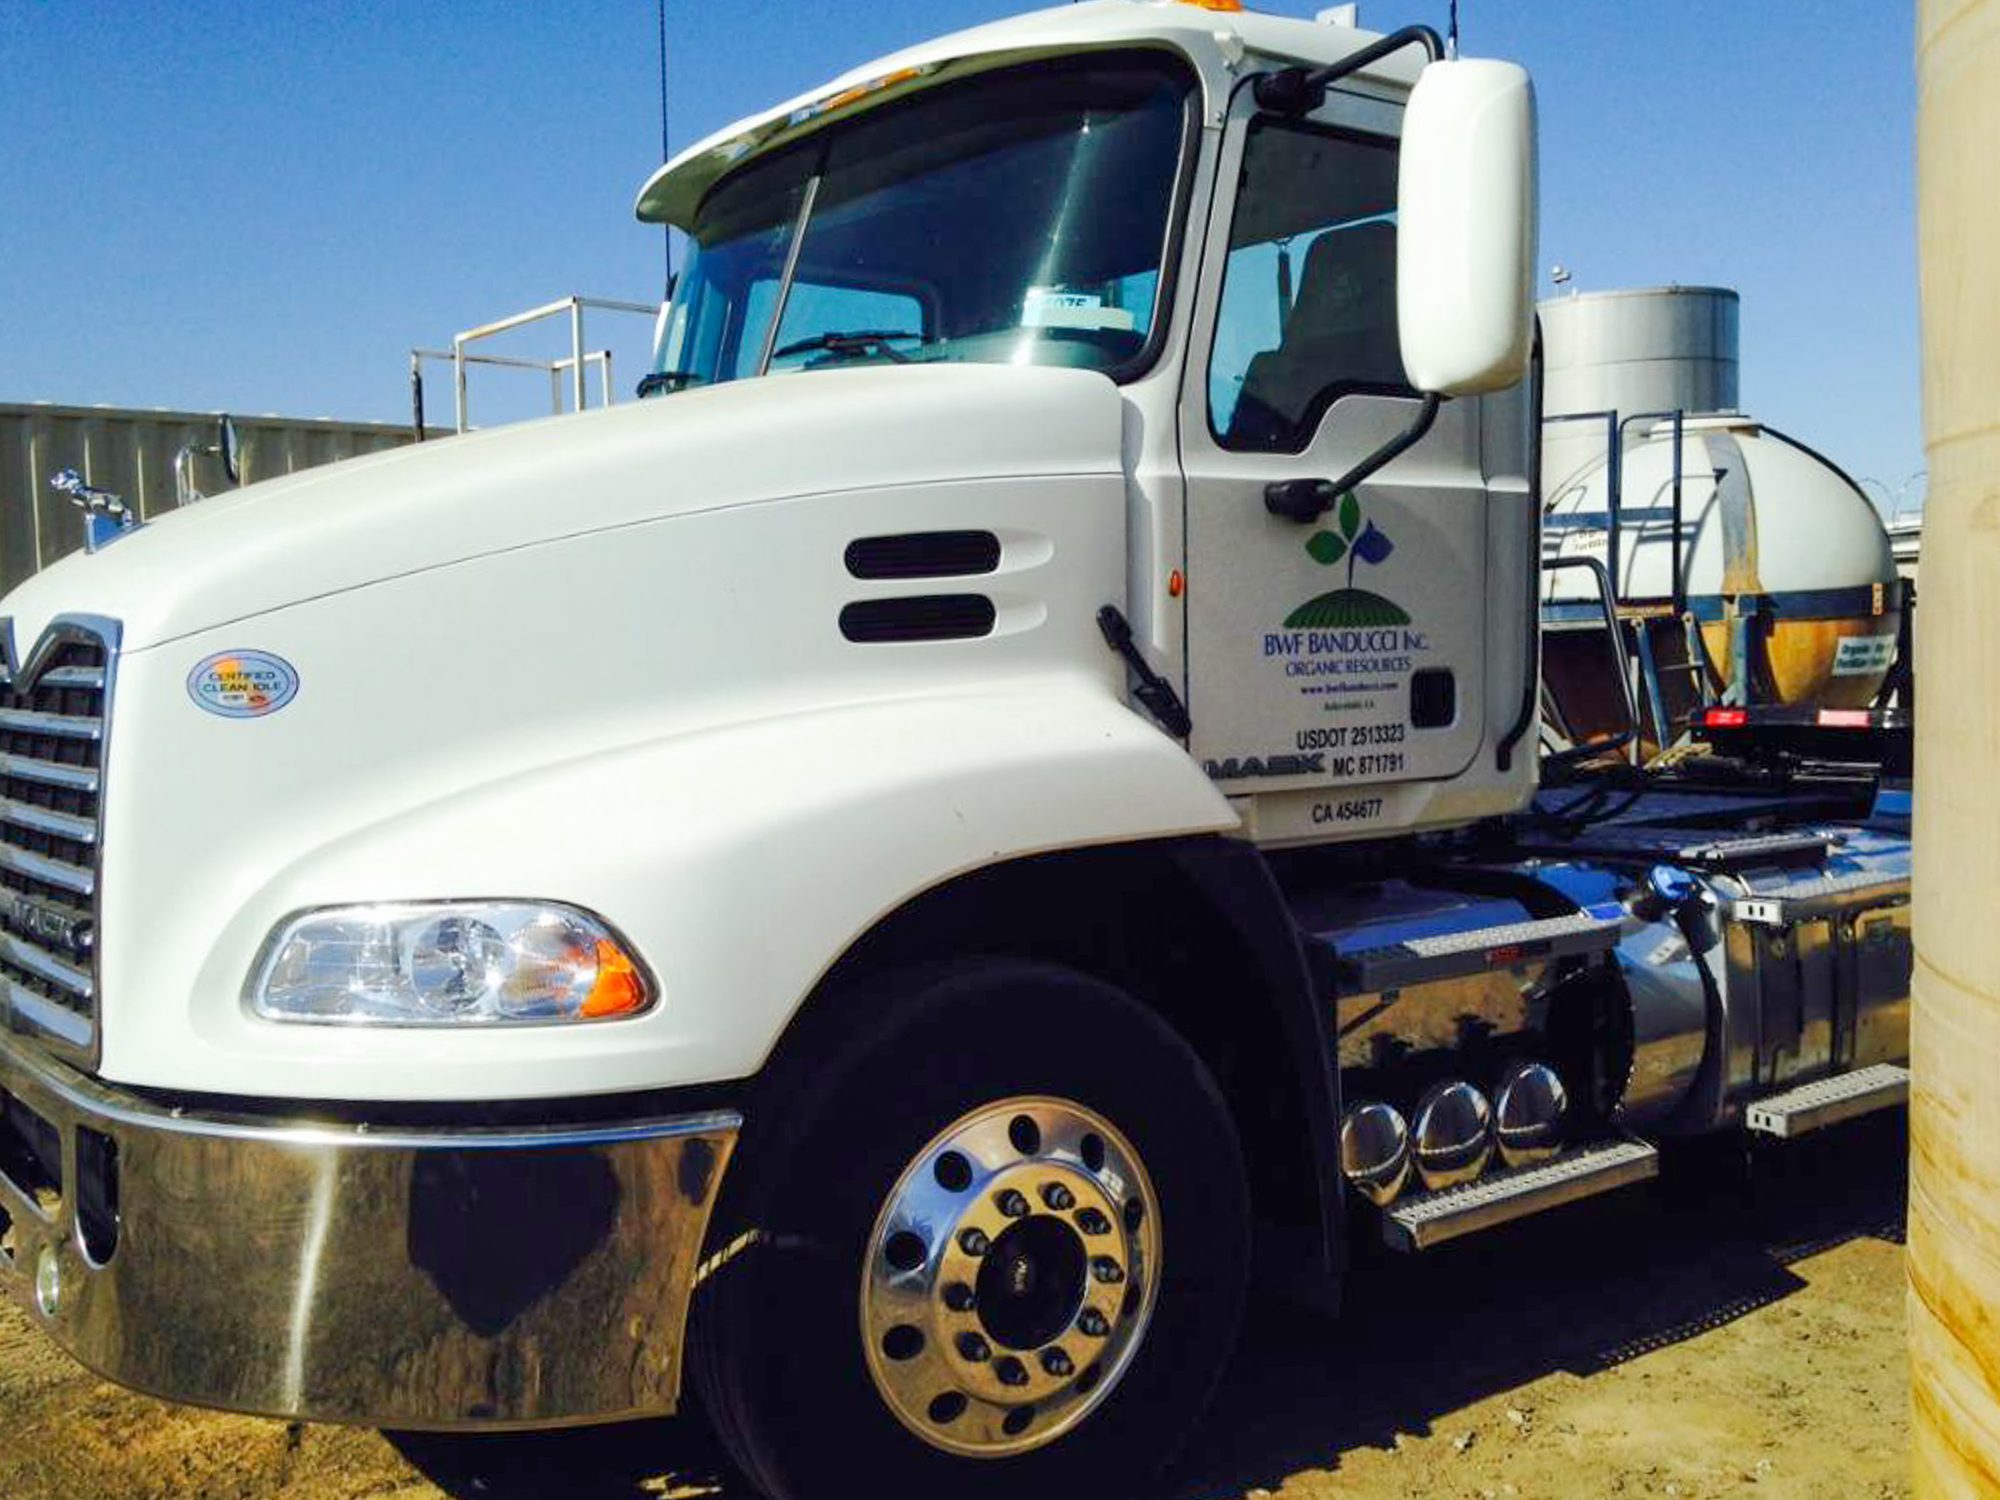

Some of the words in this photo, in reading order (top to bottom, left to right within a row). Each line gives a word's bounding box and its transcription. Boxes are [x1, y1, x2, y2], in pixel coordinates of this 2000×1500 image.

[1264, 633, 1304, 656] BWF
[1309, 630, 1397, 654] BANDUCCI
[208, 671, 276, 681] CERTIFIED
[1286, 660, 1341, 677] ORGANIC
[1345, 656, 1411, 674] RESOURCES
[202, 683, 248, 692] CLEAN
[253, 681, 281, 691] IDLE
[1297, 728, 1349, 750] USDOT
[1351, 724, 1405, 746] 2513323
[1333, 756, 1356, 778] MC
[1358, 753, 1404, 775] 871791
[1312, 803, 1333, 823] CA
[1336, 799, 1383, 819] 454677
